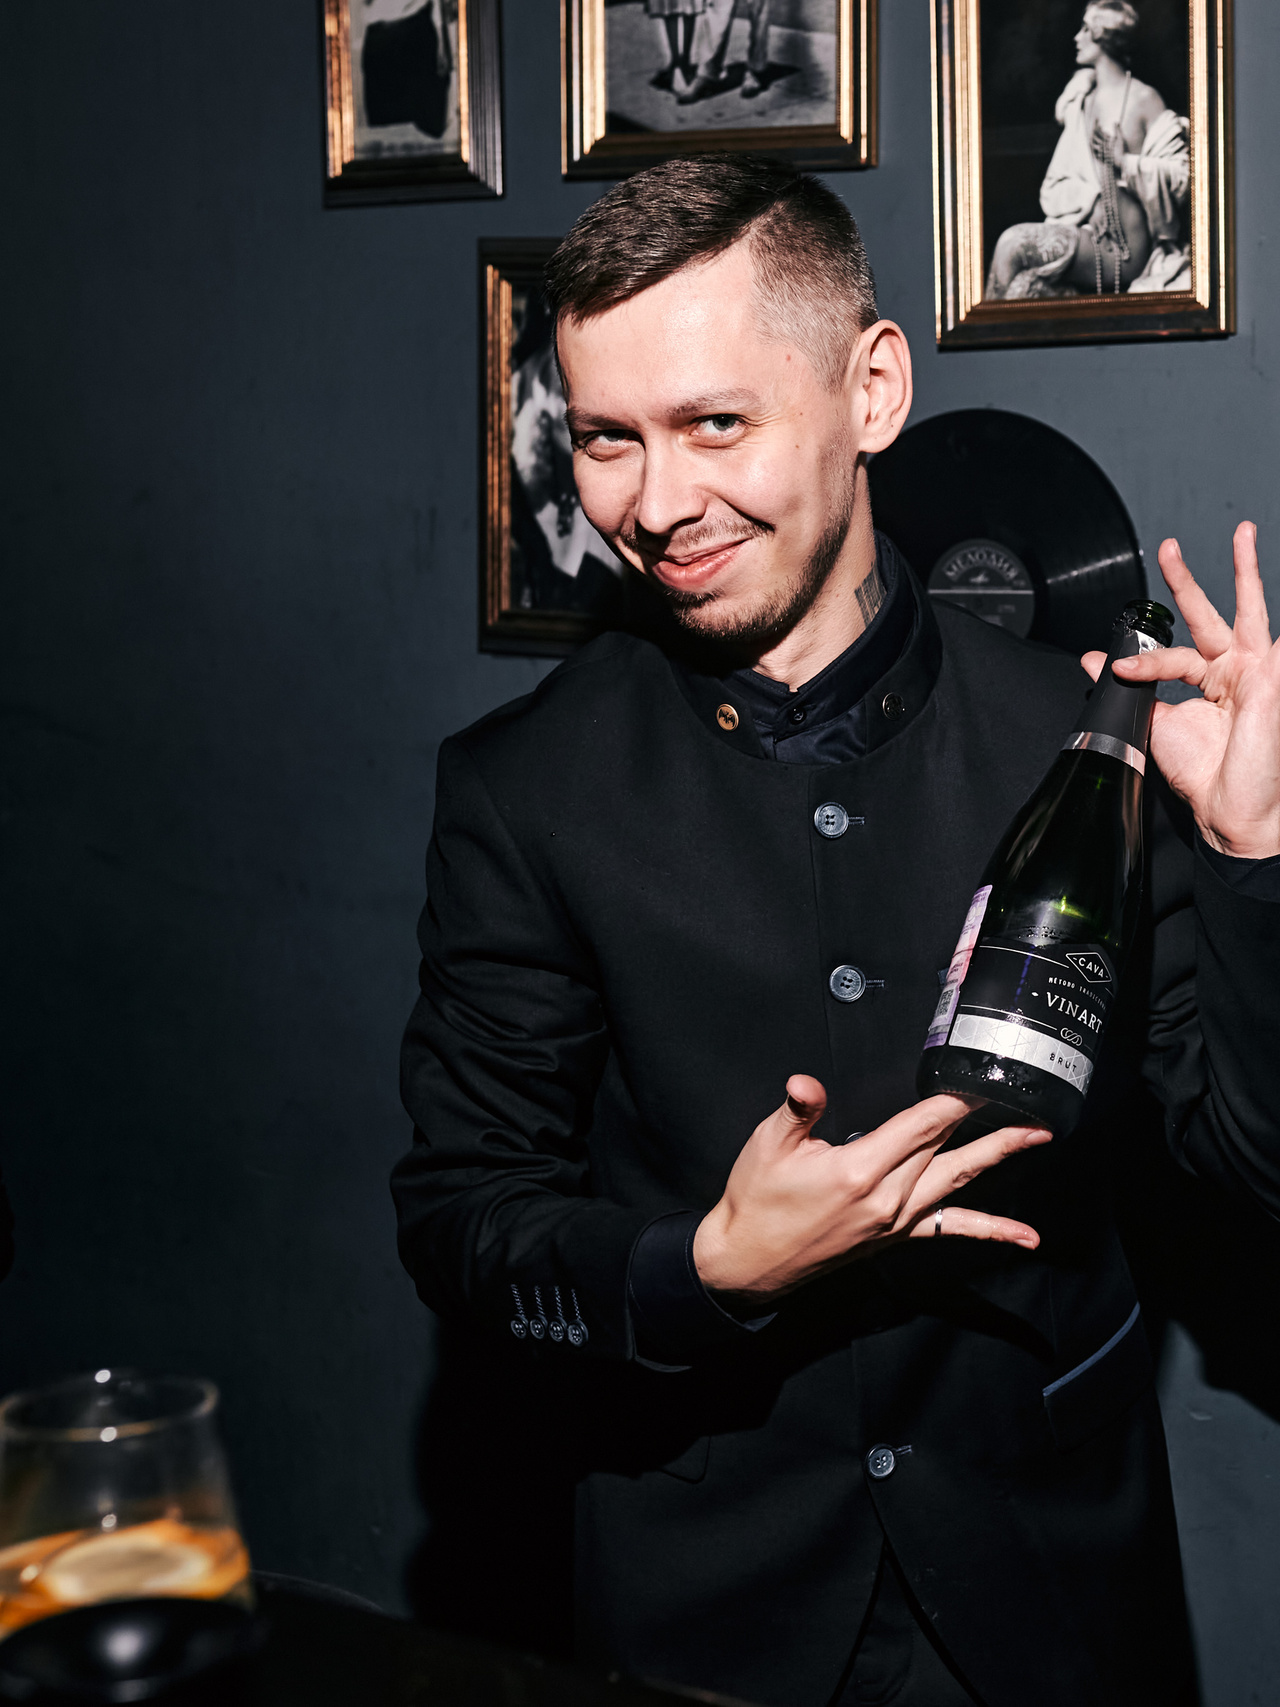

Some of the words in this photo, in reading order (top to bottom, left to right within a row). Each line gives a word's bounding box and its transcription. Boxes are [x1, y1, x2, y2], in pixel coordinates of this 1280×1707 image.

[1078, 957, 1104, 978] CAVA
[1079, 985, 1106, 1012] TRADICION
[1046, 991, 1102, 1034] VINART
[1049, 1053, 1077, 1072] BRUT
